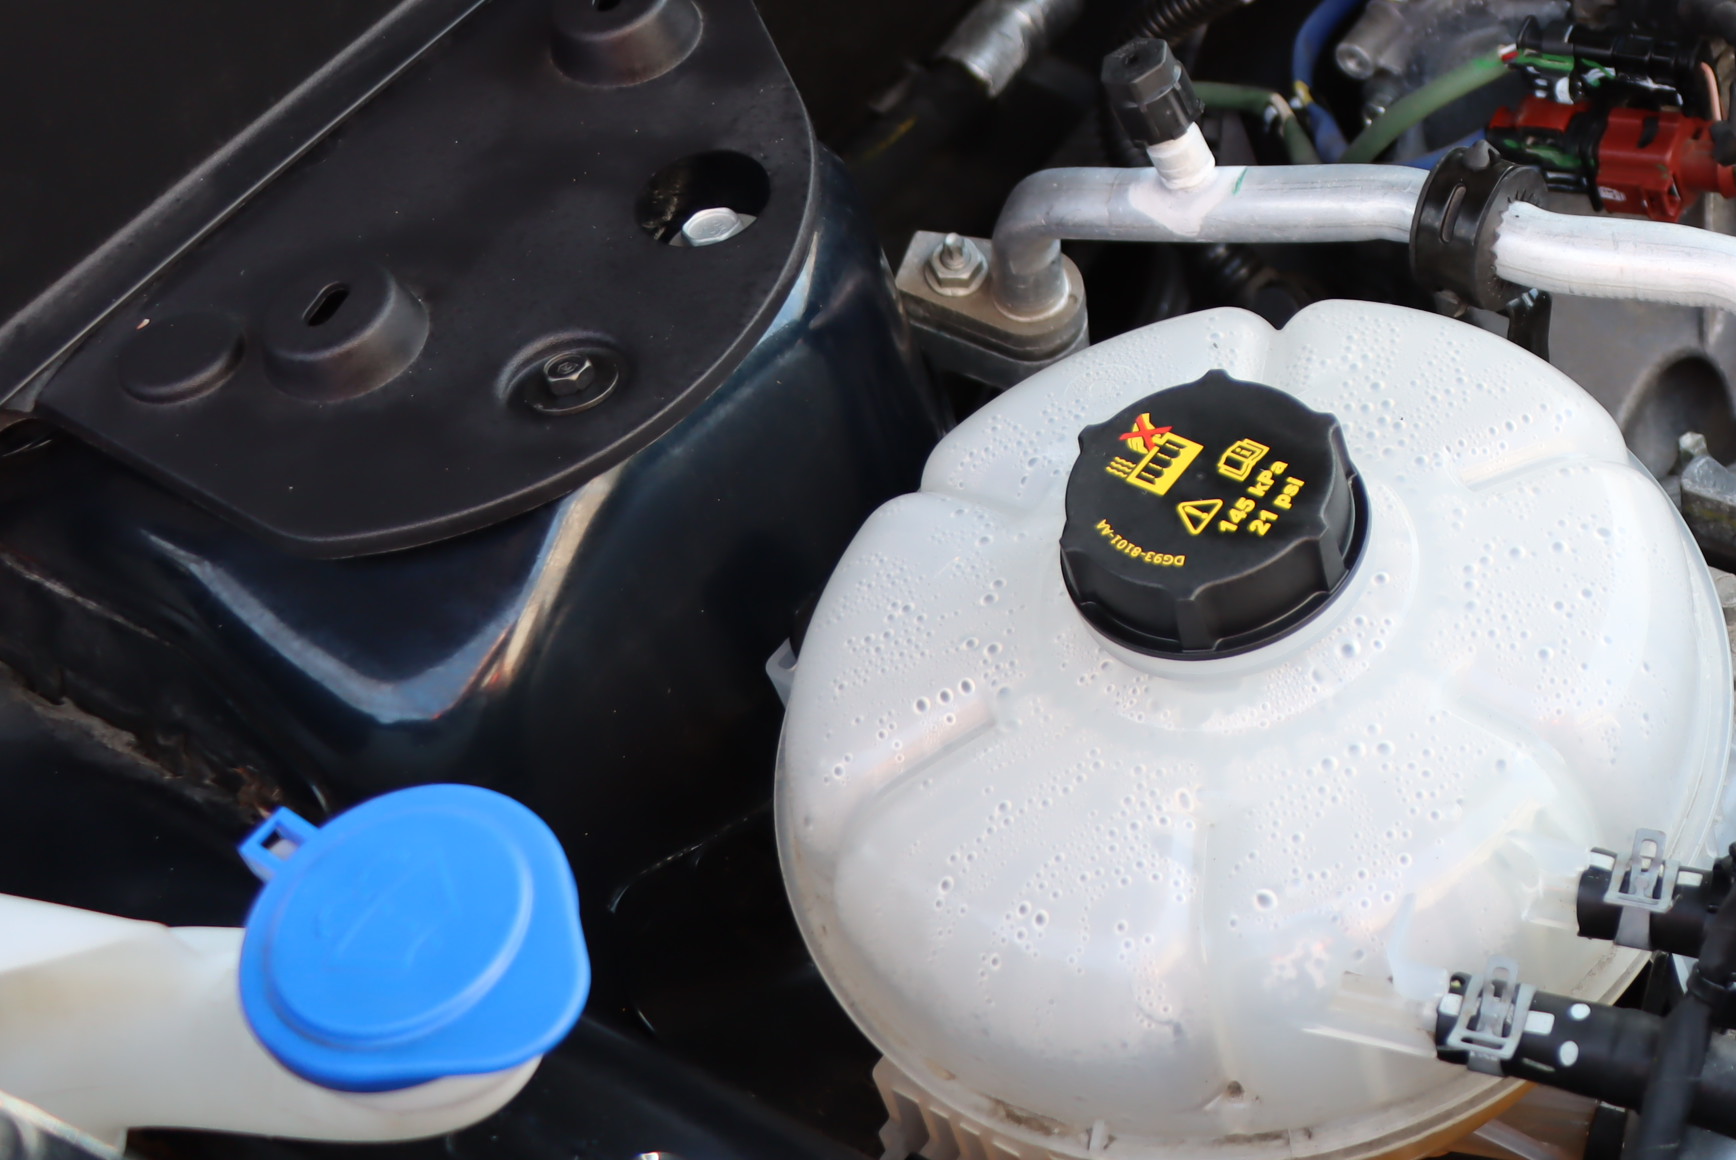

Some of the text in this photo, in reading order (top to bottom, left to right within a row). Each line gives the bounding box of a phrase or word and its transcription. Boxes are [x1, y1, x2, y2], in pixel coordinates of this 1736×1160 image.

[1217, 461, 1289, 533] 145 kPa
[1248, 476, 1305, 537] 21 psi
[1095, 518, 1187, 568] DG93-8101-AA
